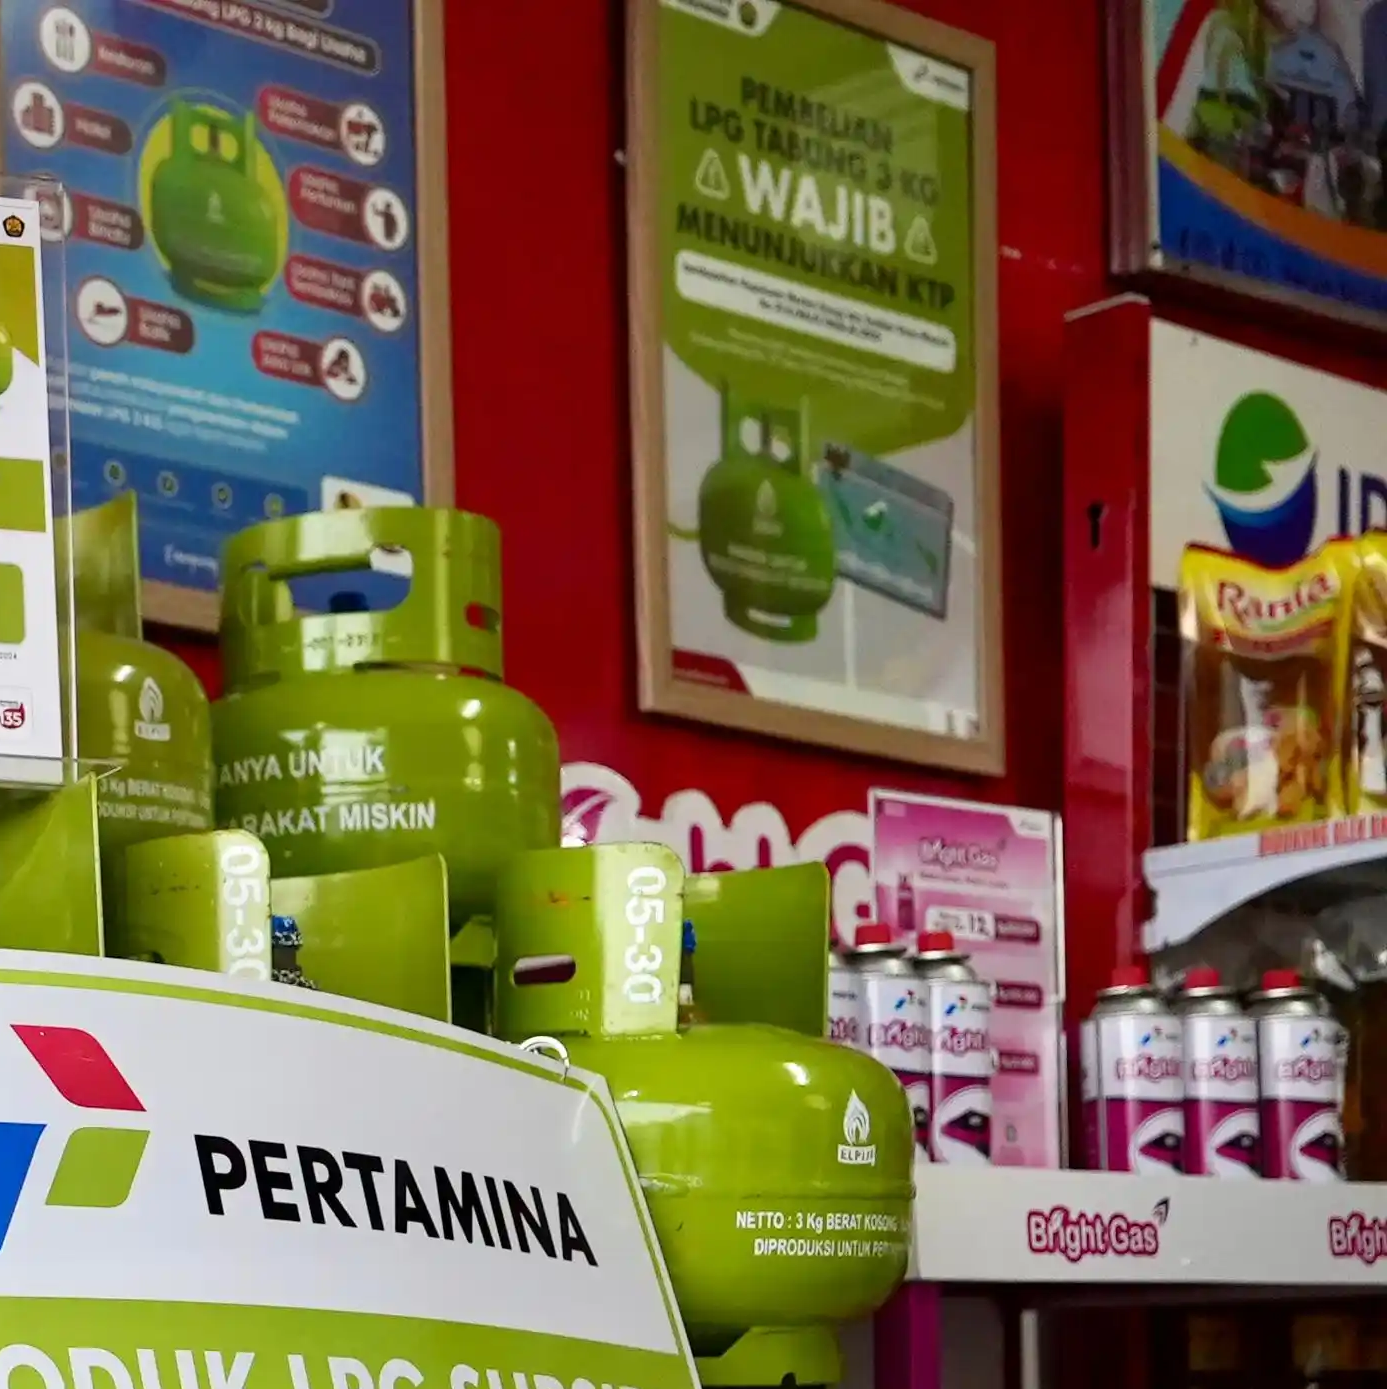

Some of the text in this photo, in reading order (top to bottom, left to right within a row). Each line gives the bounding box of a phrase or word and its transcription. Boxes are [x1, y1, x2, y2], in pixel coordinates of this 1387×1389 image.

[689, 98, 938, 207] LPG TABUNG 3 KG
[741, 75, 893, 154] PEMBELIAN
[738, 153, 896, 254] WAJIB
[677, 203, 898, 297] MENUNJUKKAN
[906, 274, 955, 308] KTP
[218, 744, 386, 785] ANYA UNTUK
[338, 799, 437, 831] MISKIN
[622, 864, 667, 1006] 05-30
[194, 1133, 599, 1267] PERTAMINA
[1028, 1204, 1162, 1264] Bright Gas
[1328, 1211, 1387, 1264] Brigh
